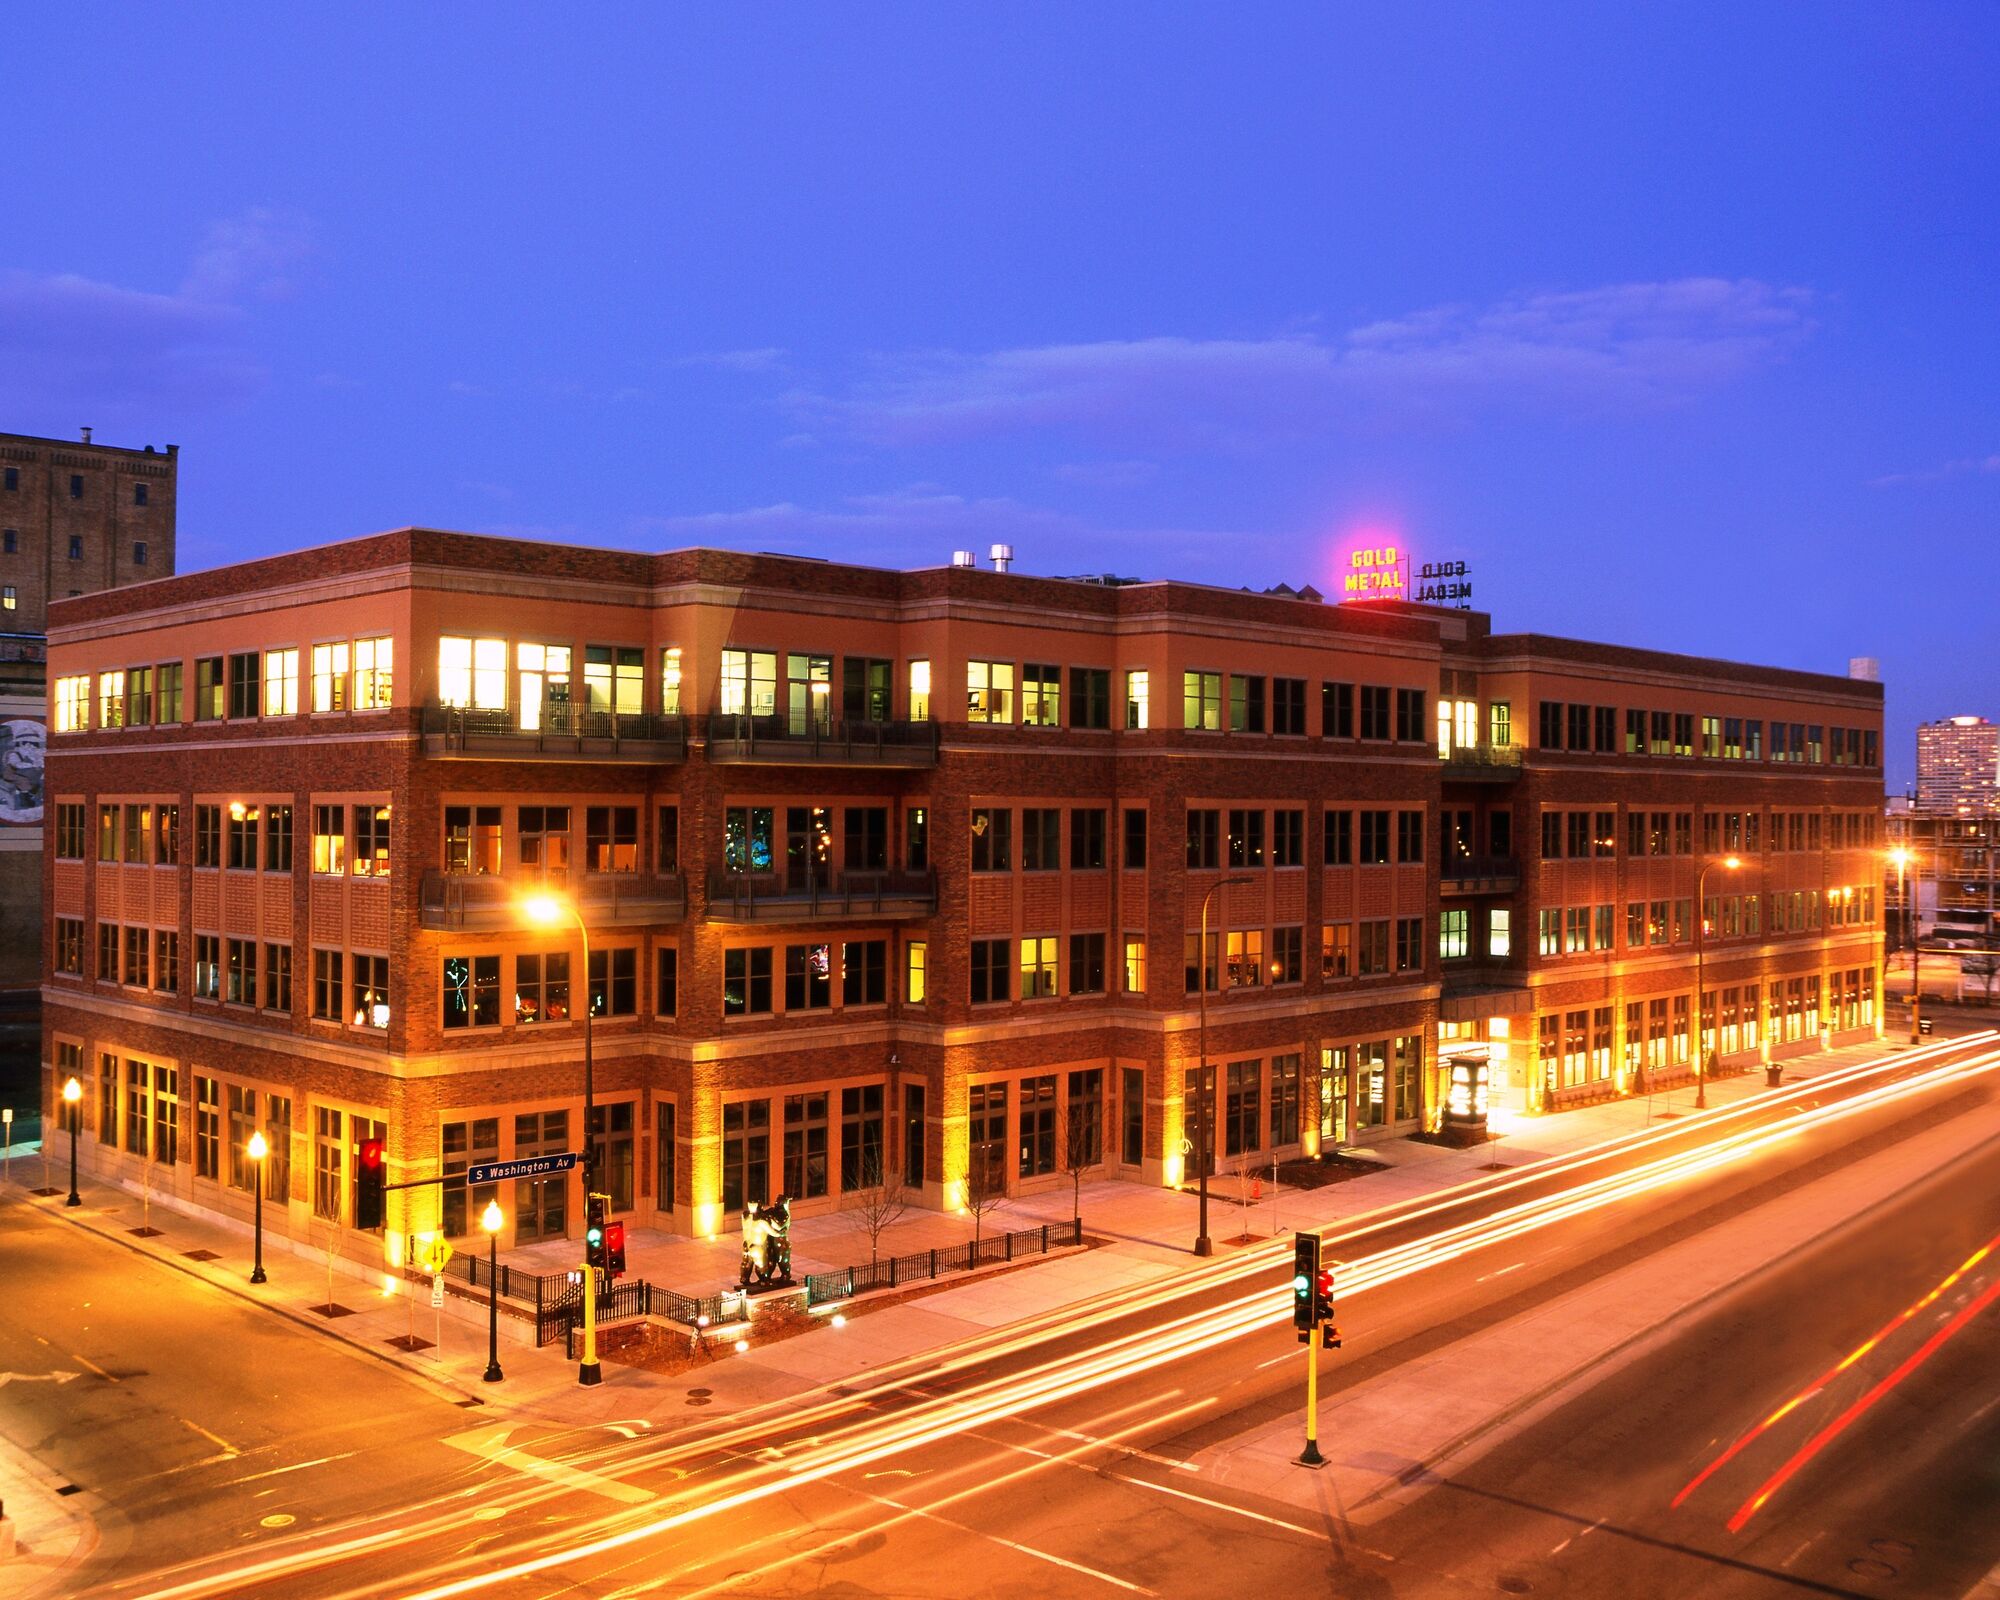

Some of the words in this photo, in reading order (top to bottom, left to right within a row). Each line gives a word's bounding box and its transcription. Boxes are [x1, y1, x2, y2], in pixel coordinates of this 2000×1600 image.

[1352, 547, 1396, 568] GOLD
[1345, 570, 1403, 591] MEDAL
[476, 1170, 483, 1180] S
[489, 1160, 550, 1178] Washington
[556, 1158, 569, 1168] Av
